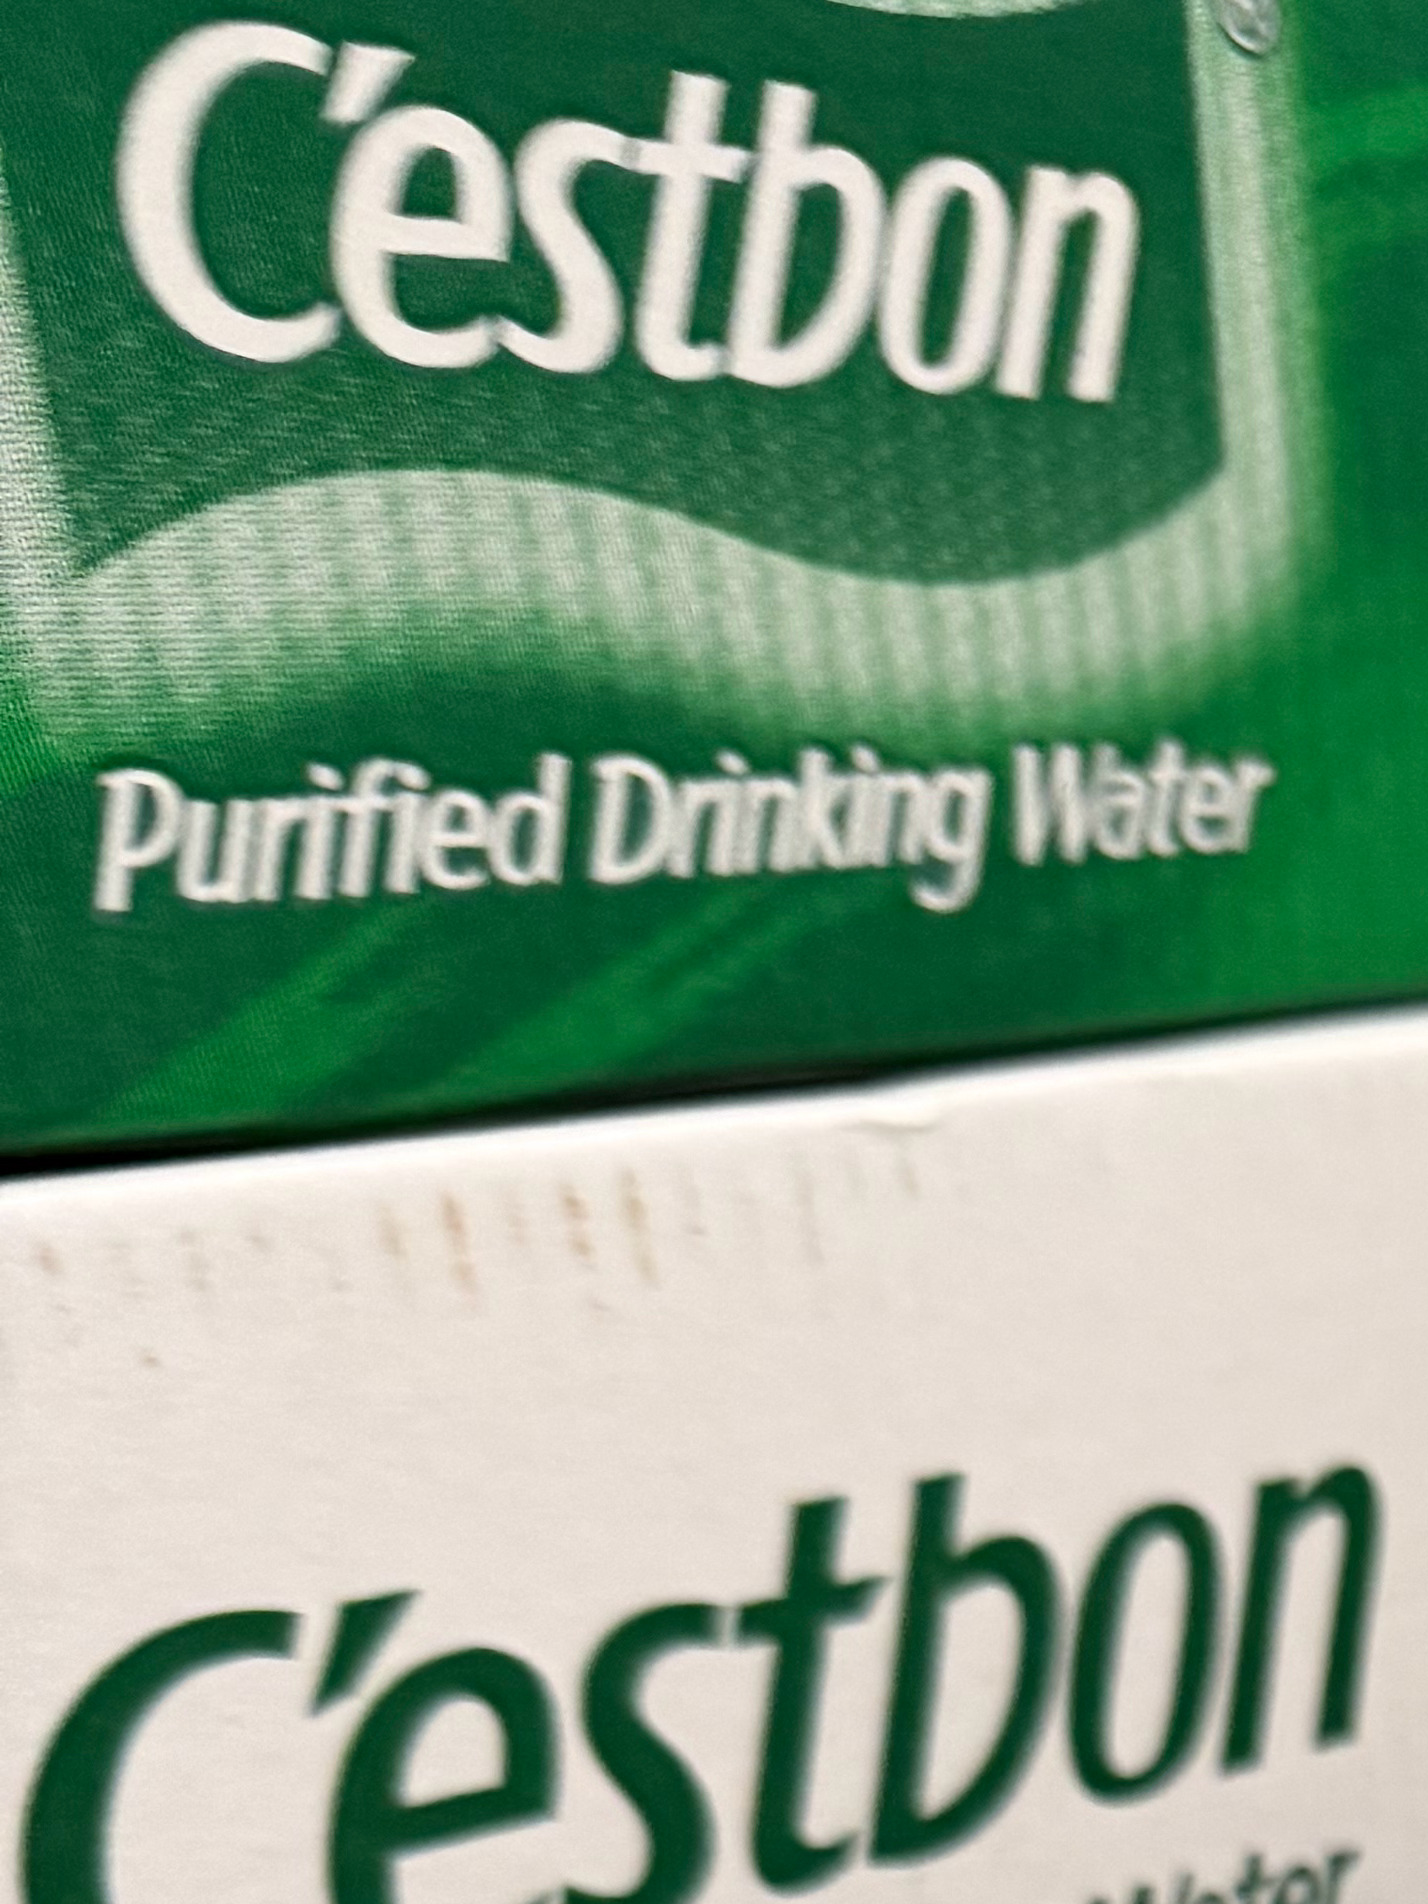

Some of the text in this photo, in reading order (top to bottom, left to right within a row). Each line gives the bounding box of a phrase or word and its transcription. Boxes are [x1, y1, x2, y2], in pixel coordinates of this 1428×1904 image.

[114, 18, 1141, 404] C'estbon
[92, 738, 1276, 914] Purified Drinking Water
